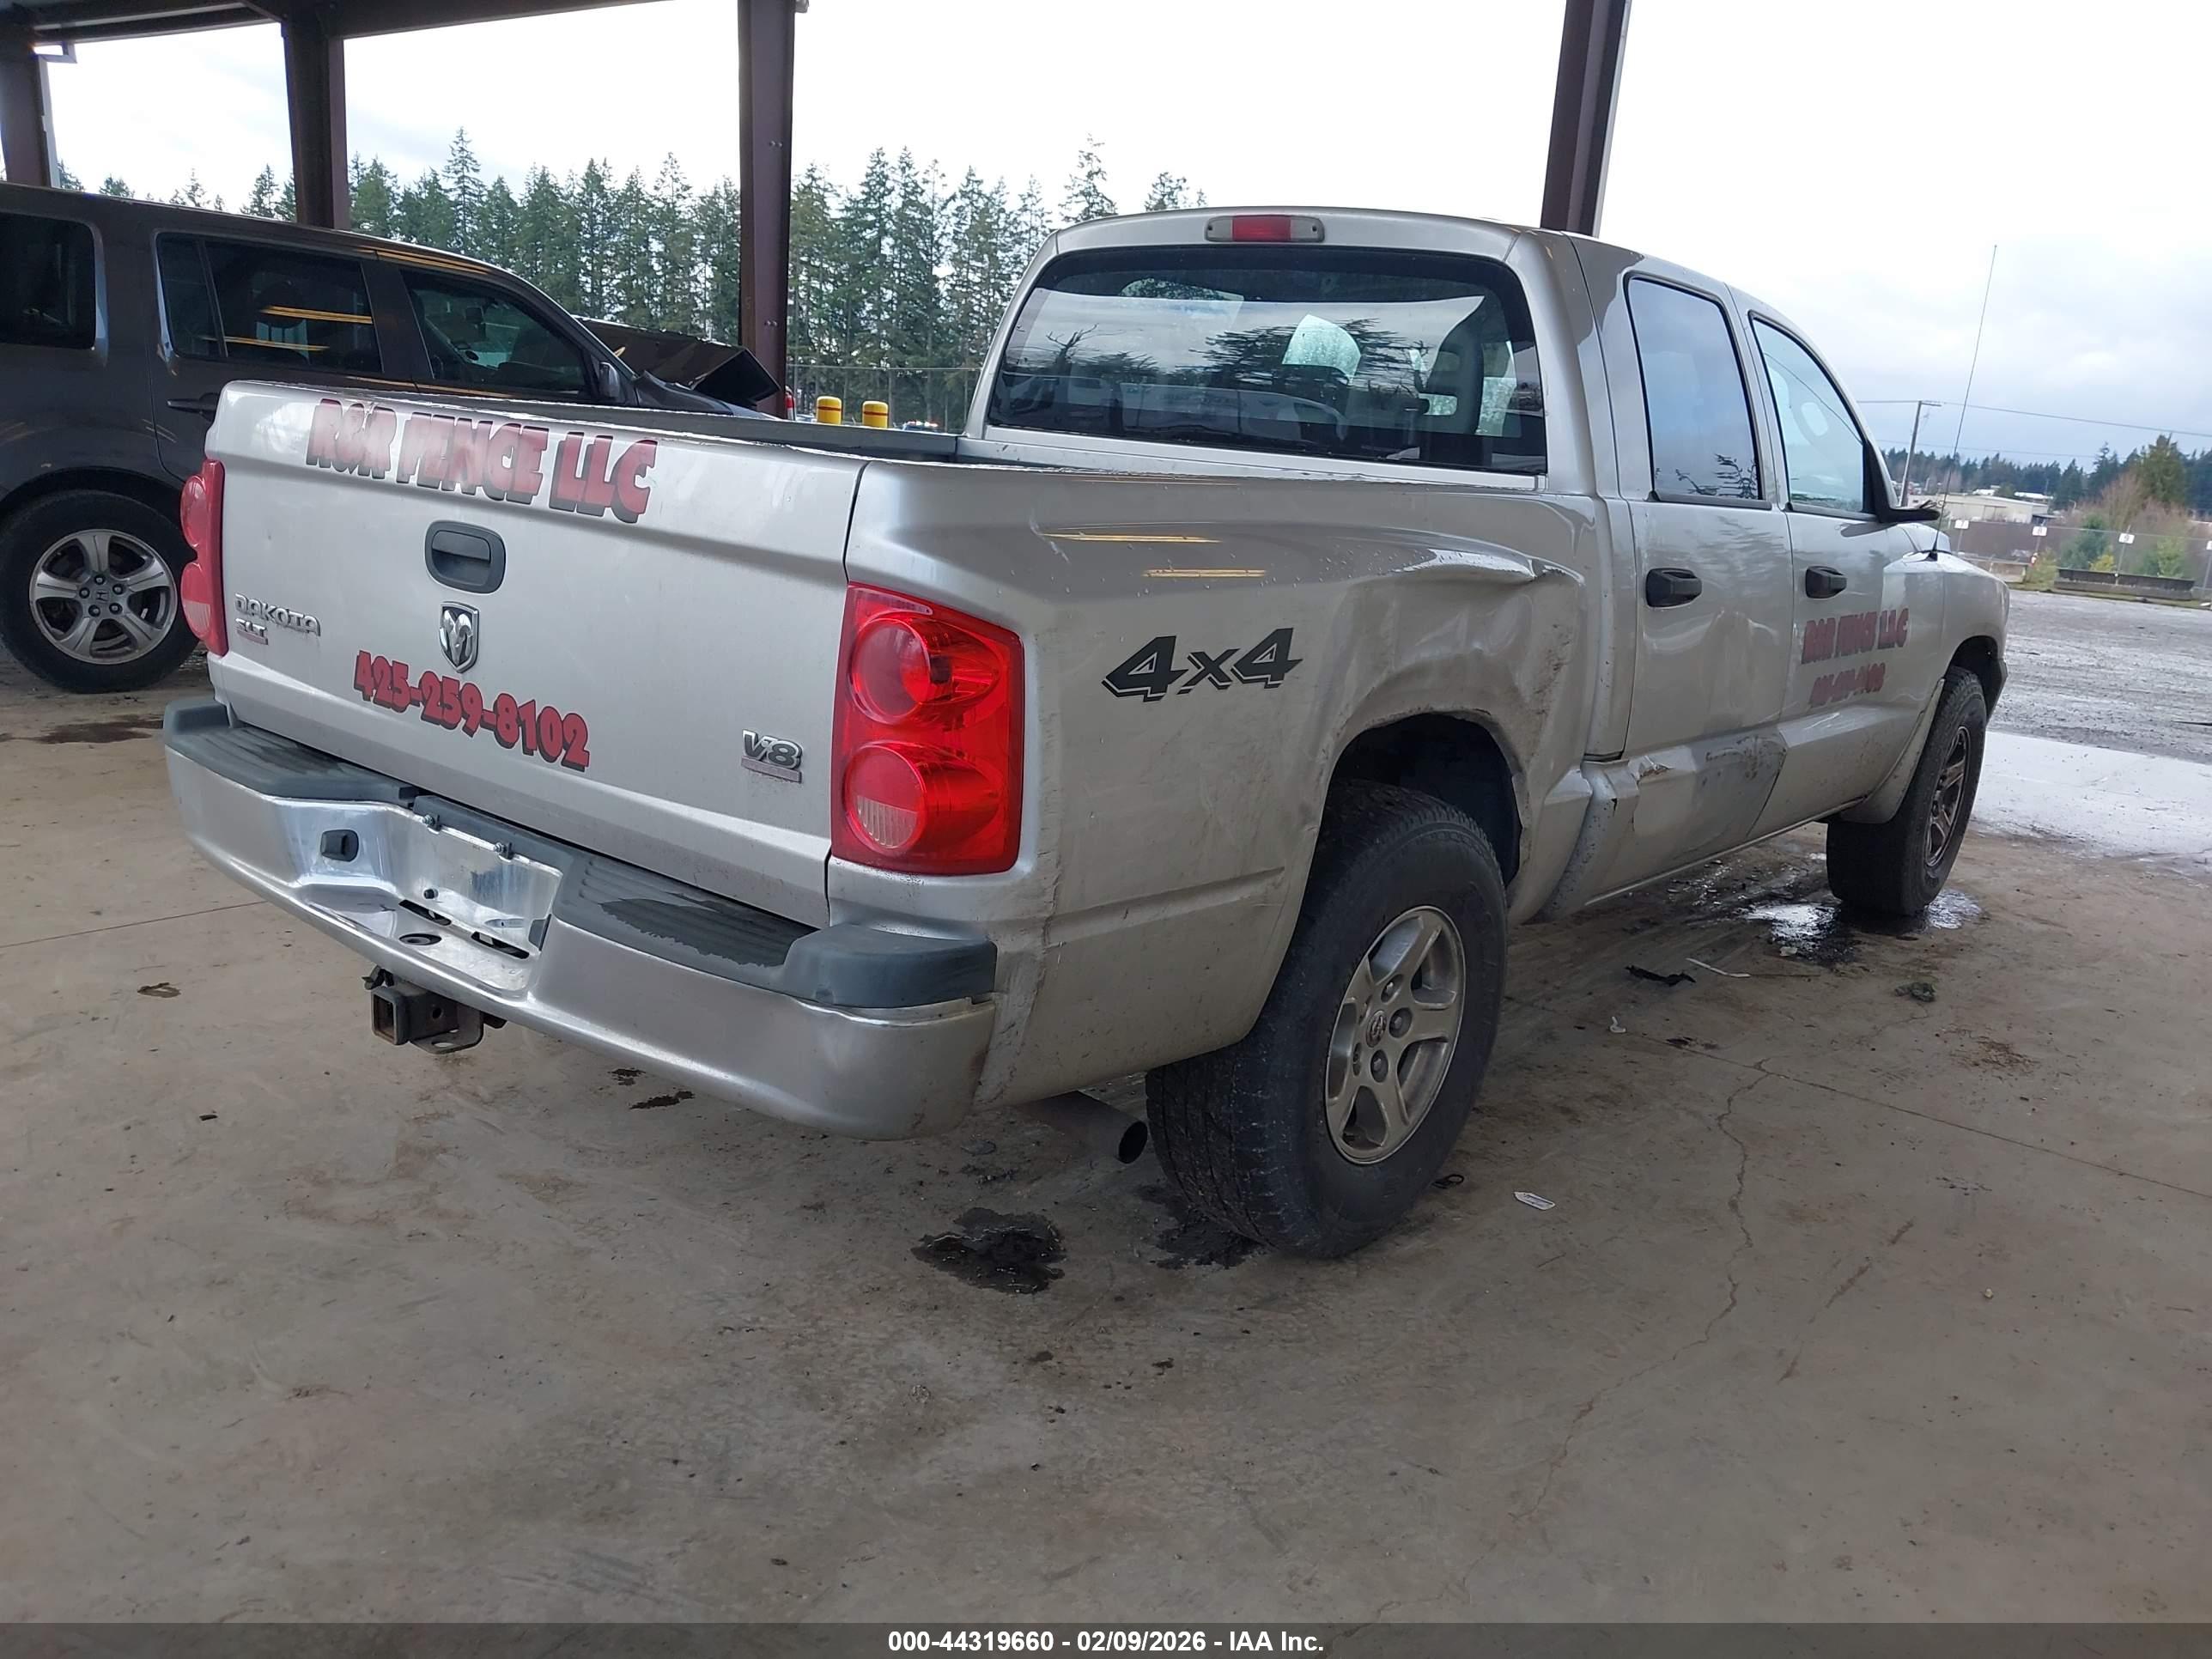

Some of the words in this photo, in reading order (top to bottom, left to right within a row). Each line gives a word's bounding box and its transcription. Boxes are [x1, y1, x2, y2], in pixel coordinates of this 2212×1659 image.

[307, 398, 397, 479] R&R
[396, 411, 550, 505] FENCE
[549, 431, 658, 524] LLC
[234, 592, 320, 636] DAKOTA
[1877, 608, 1909, 649] LLC
[1102, 628, 1304, 702] 4x4
[354, 650, 590, 772] 425-259-8102
[742, 729, 802, 769] V8
